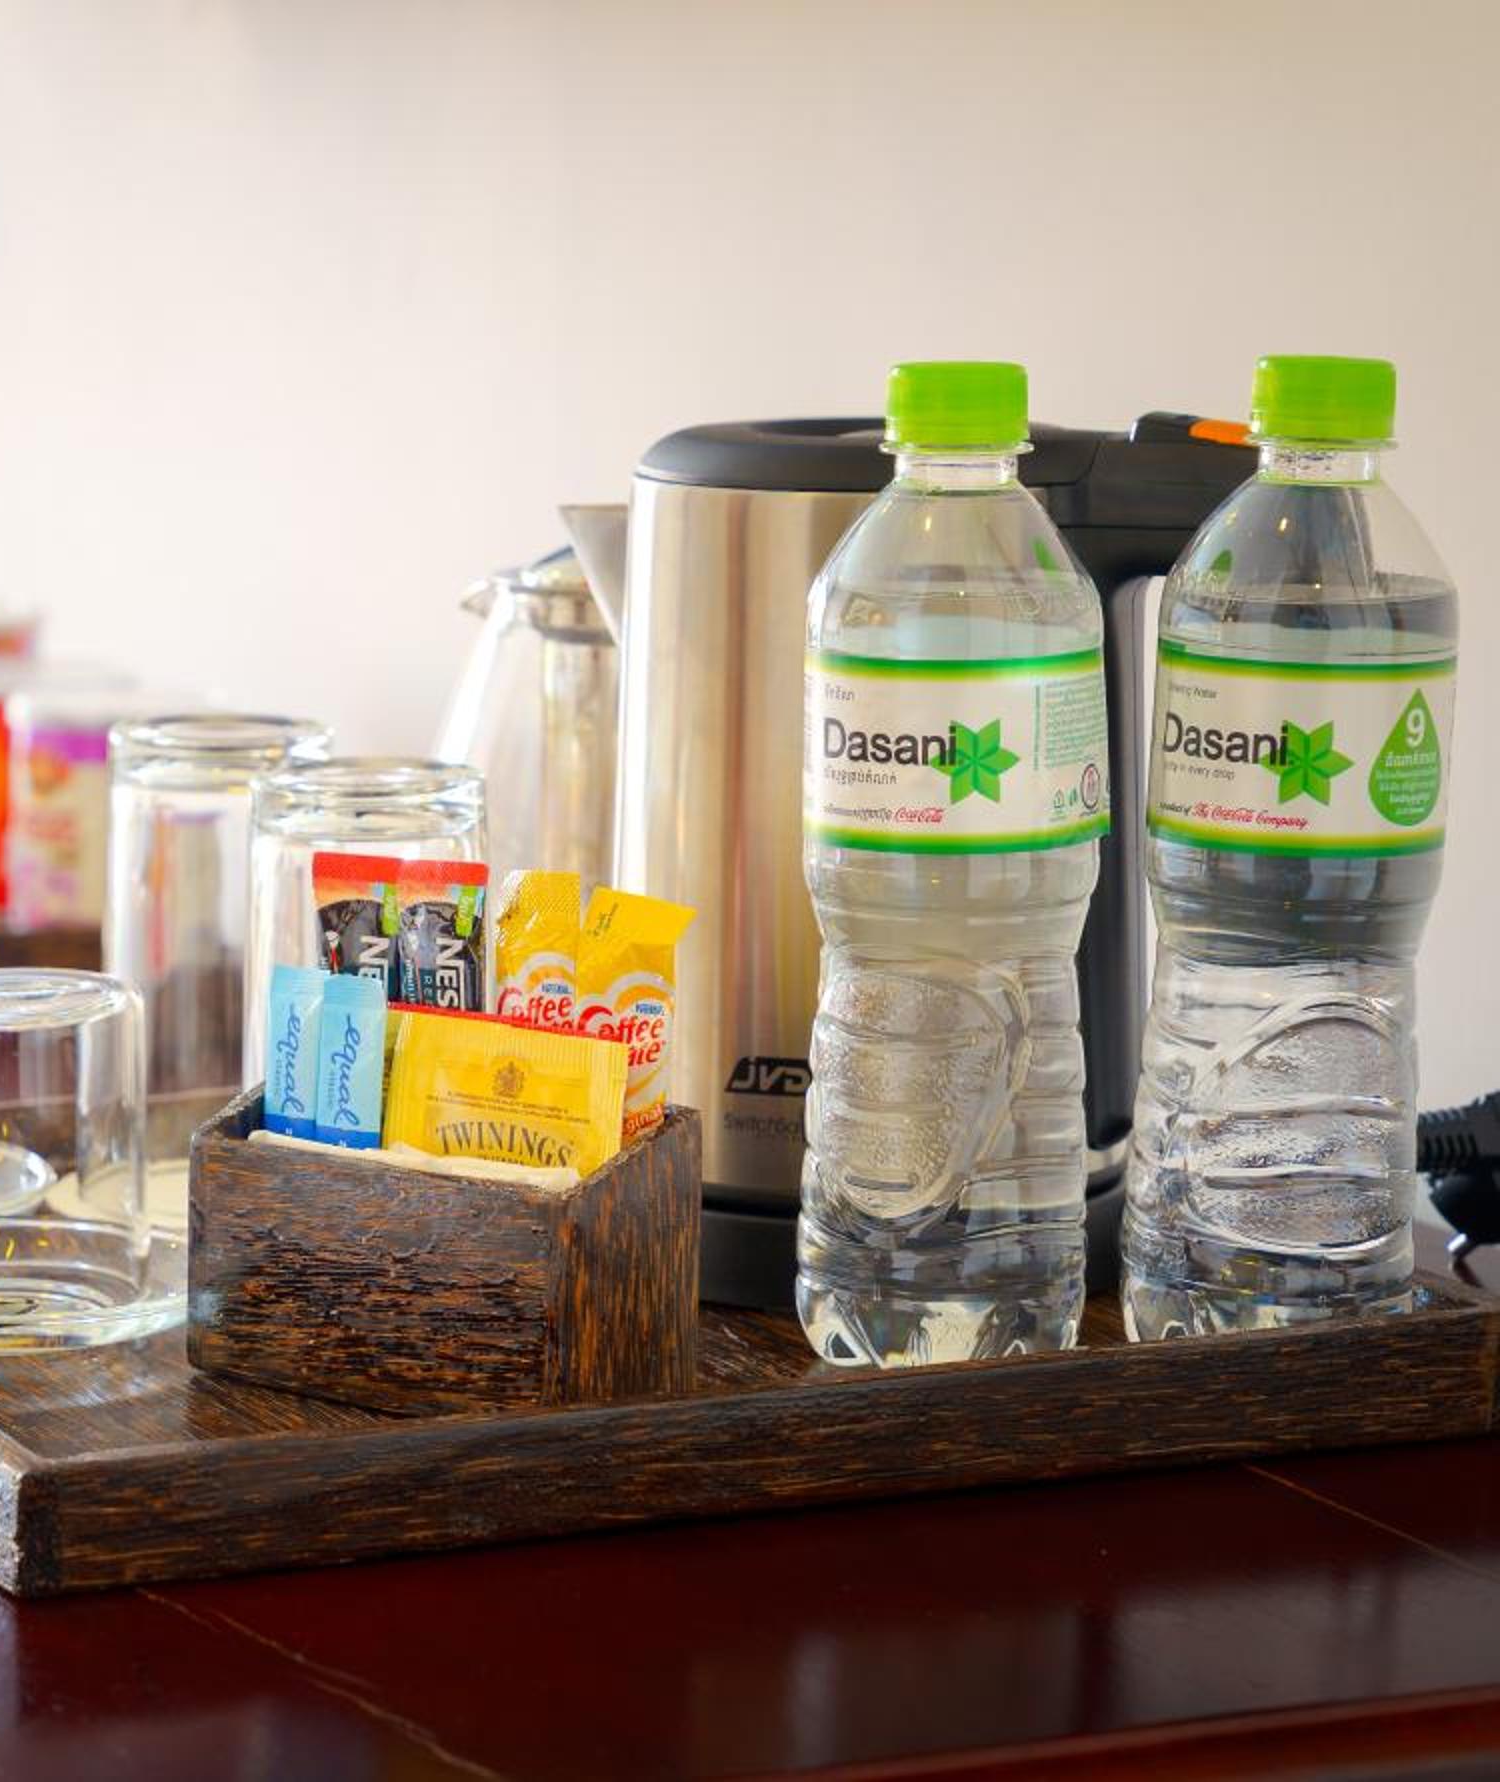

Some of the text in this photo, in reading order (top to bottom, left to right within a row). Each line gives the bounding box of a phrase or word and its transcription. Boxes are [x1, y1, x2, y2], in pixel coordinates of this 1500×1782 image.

[823, 717, 957, 766] Dasani
[1161, 711, 1288, 766] Dasani
[1406, 708, 1426, 748] 9
[435, 937, 465, 1010] NES
[276, 1001, 305, 1114] equal
[331, 1013, 361, 1127] equal
[435, 1120, 579, 1167] TWININGS
